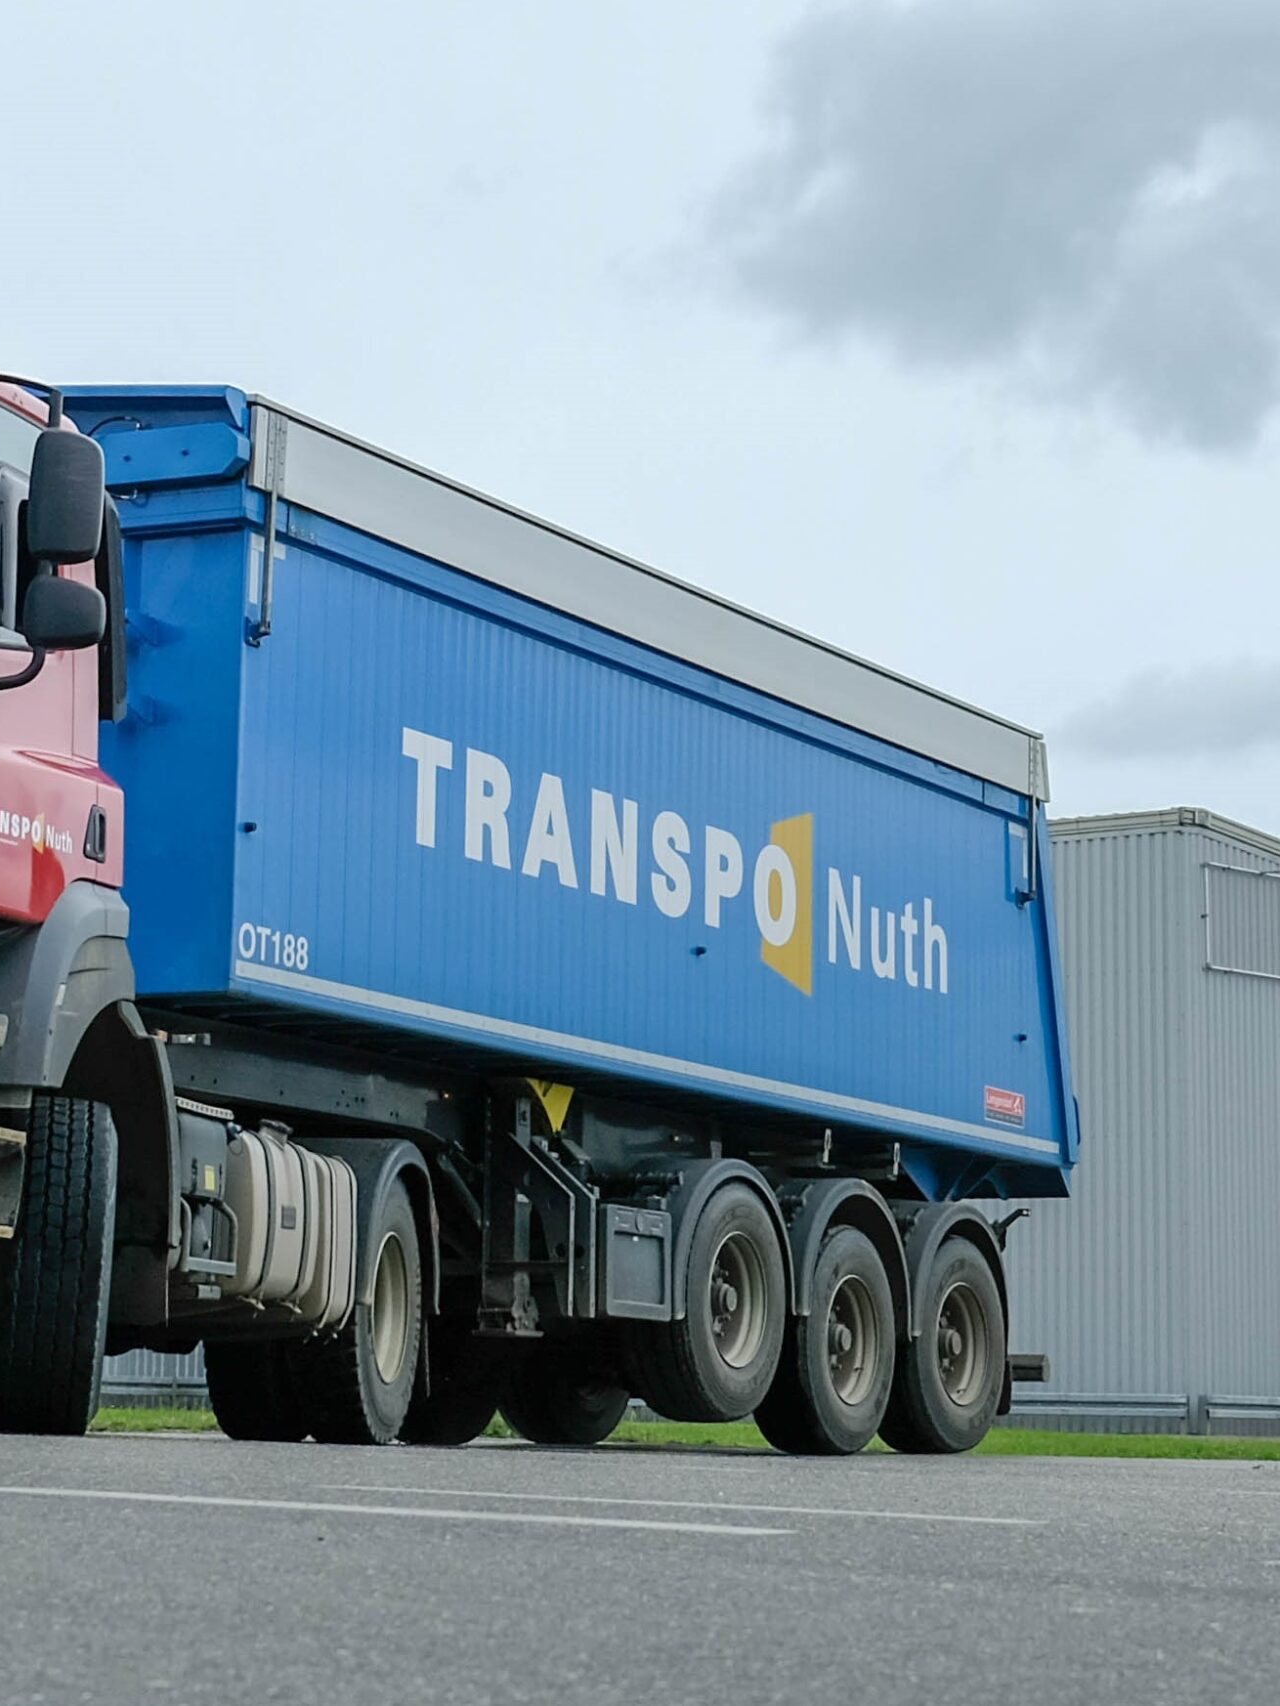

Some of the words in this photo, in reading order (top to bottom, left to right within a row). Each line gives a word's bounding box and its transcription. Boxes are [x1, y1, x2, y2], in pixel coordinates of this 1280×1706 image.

[45, 824, 72, 854] Nuth
[402, 726, 797, 947] TRANSPO
[827, 866, 949, 995] Nuth
[238, 922, 308, 970] OT188
